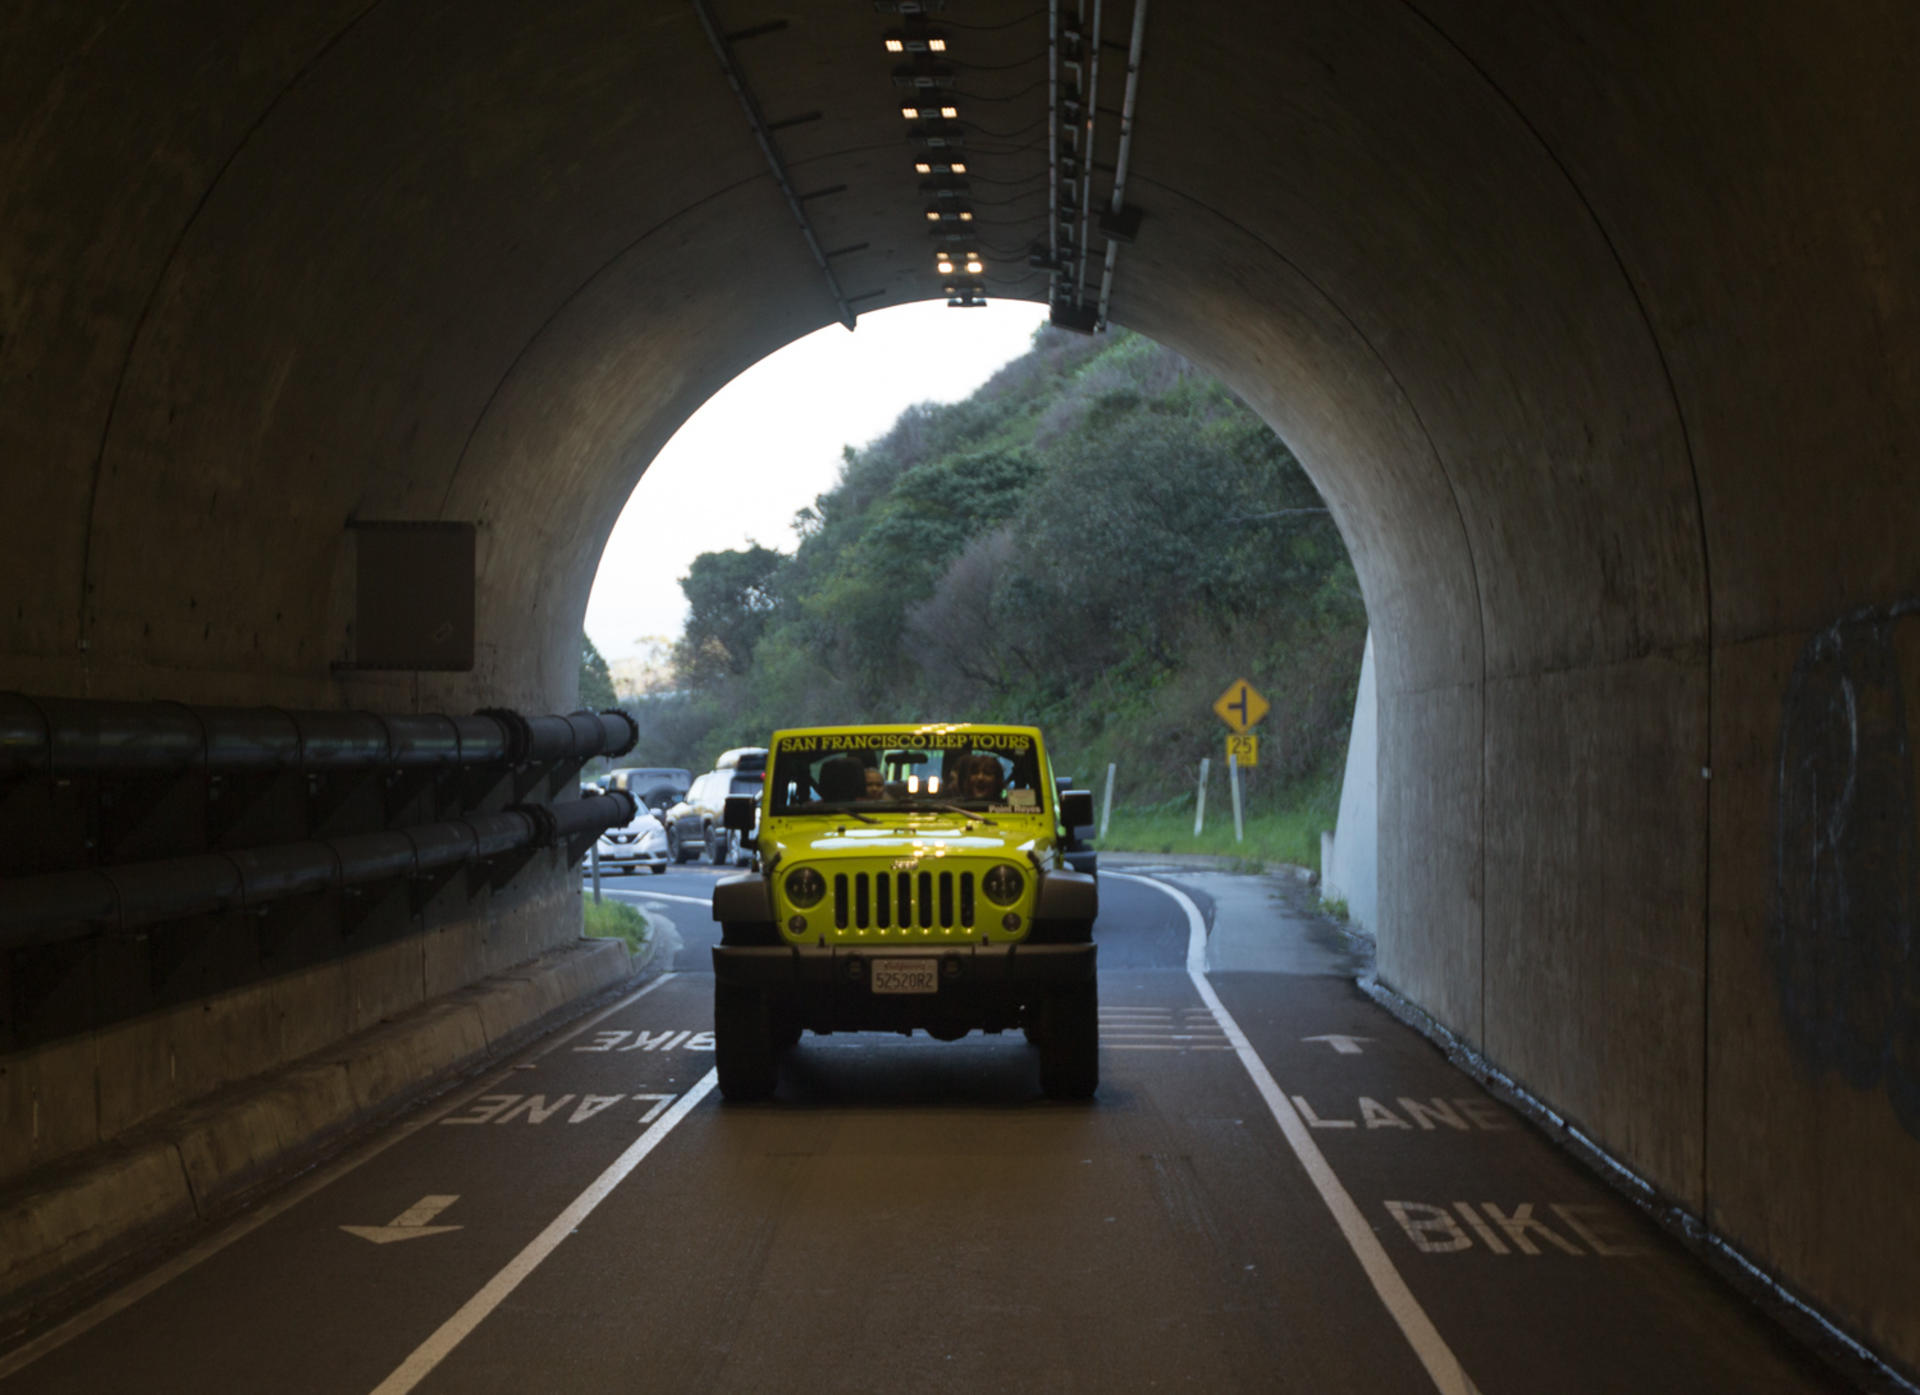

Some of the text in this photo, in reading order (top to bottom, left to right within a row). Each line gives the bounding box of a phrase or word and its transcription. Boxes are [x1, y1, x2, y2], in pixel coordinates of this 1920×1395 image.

[781, 734, 1030, 752] SAN FRANCISCO JEEP TOURS
[1232, 736, 1252, 754] 25
[439, 1093, 678, 1124] LANE
[1291, 1095, 1522, 1131] LANE
[1383, 1200, 1648, 1256] BIKE
